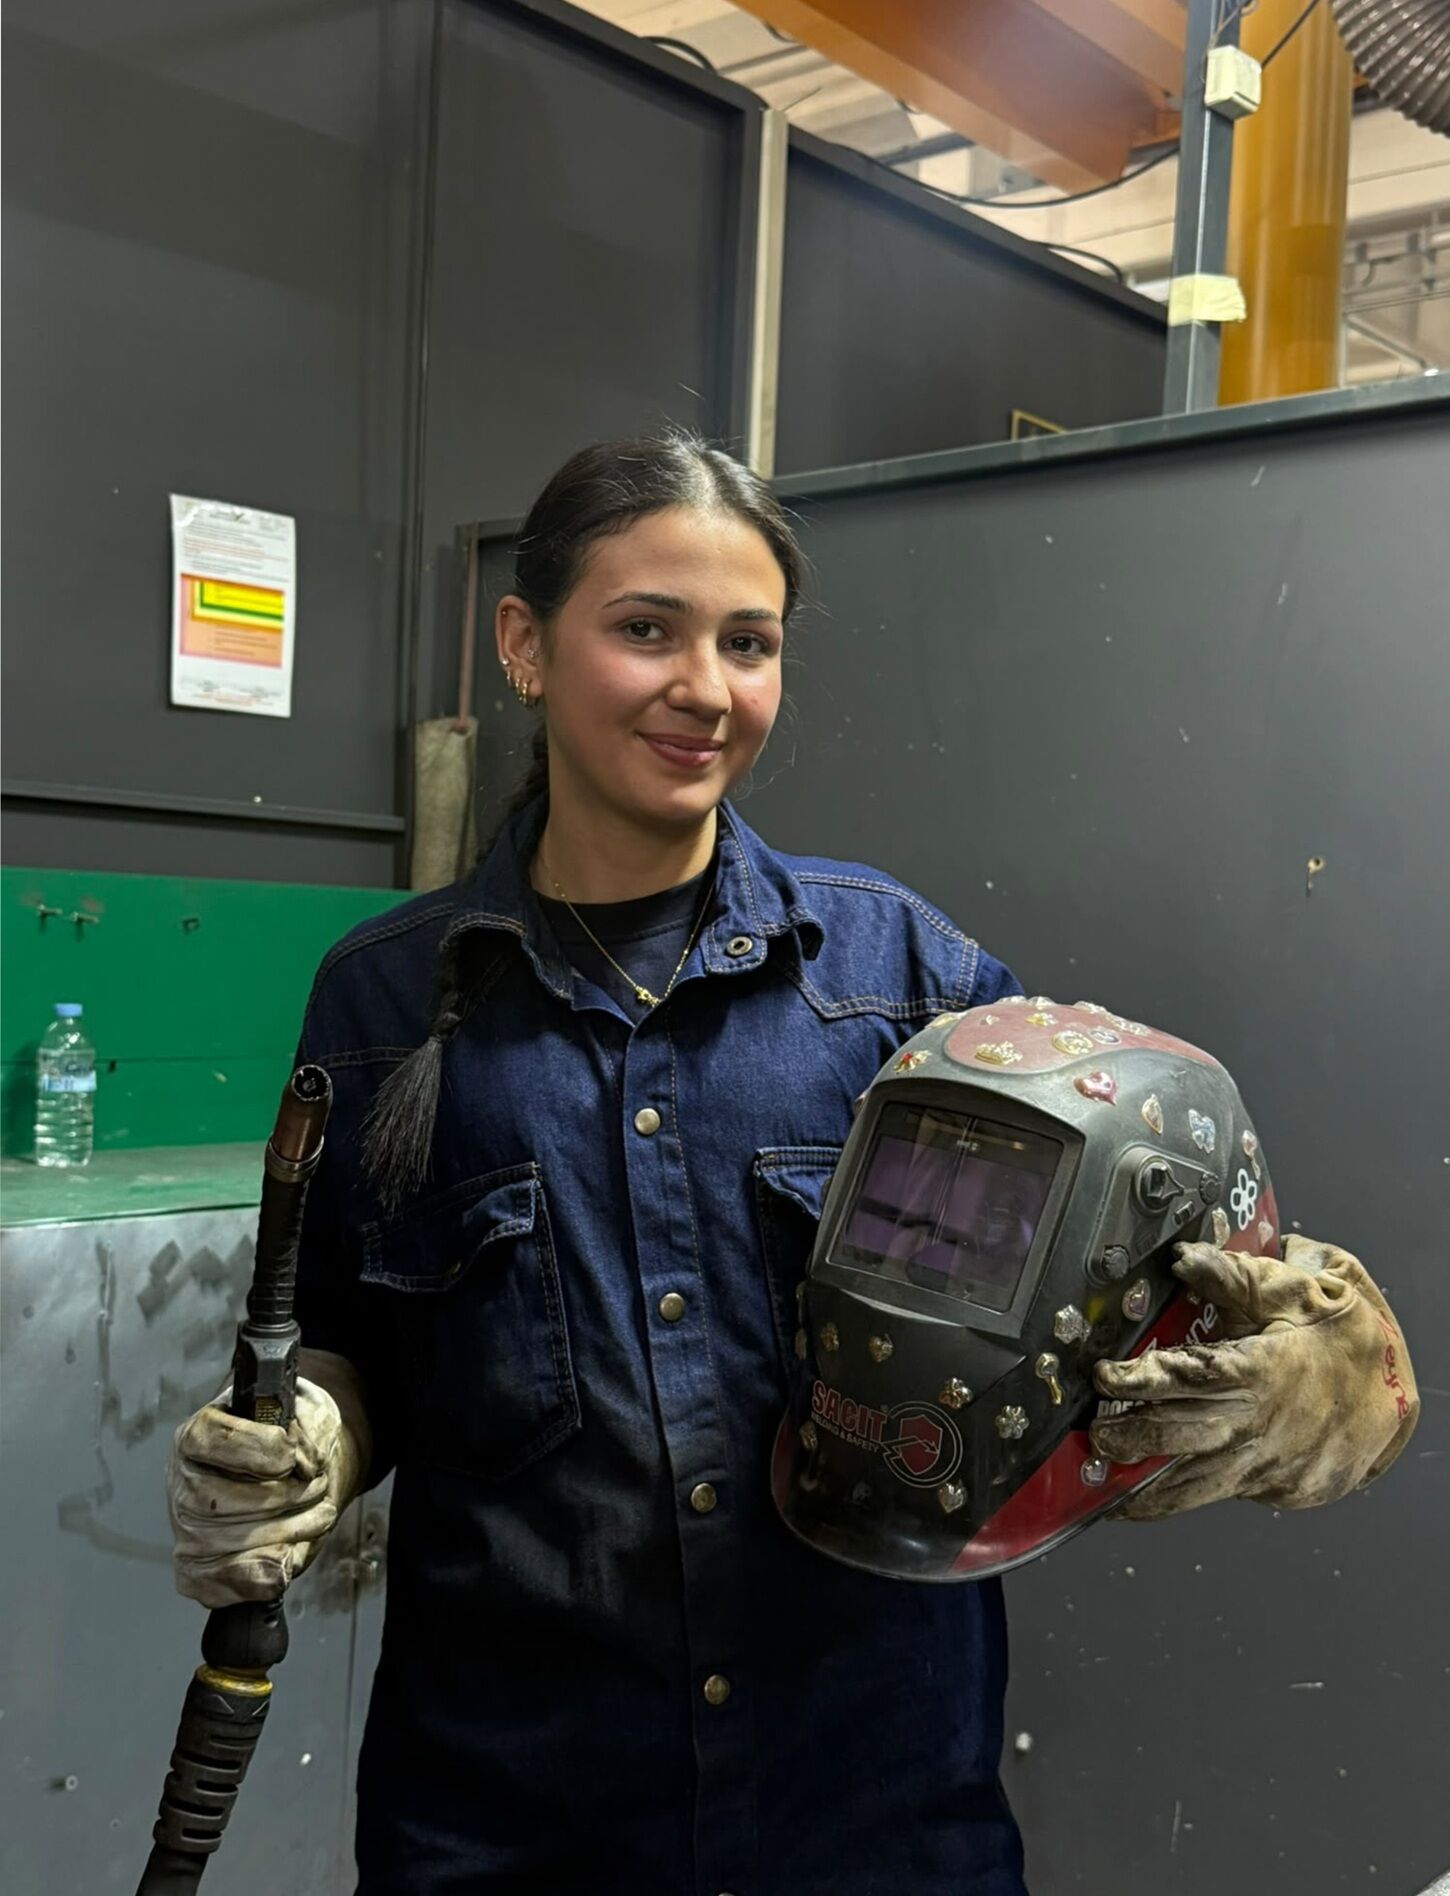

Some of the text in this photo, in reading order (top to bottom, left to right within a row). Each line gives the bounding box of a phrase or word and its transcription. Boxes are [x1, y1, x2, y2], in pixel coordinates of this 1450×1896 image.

[1377, 1309, 1410, 1422] Zeyne
[811, 1380, 887, 1442] SACIT
[846, 1432, 879, 1453] SAFETY
